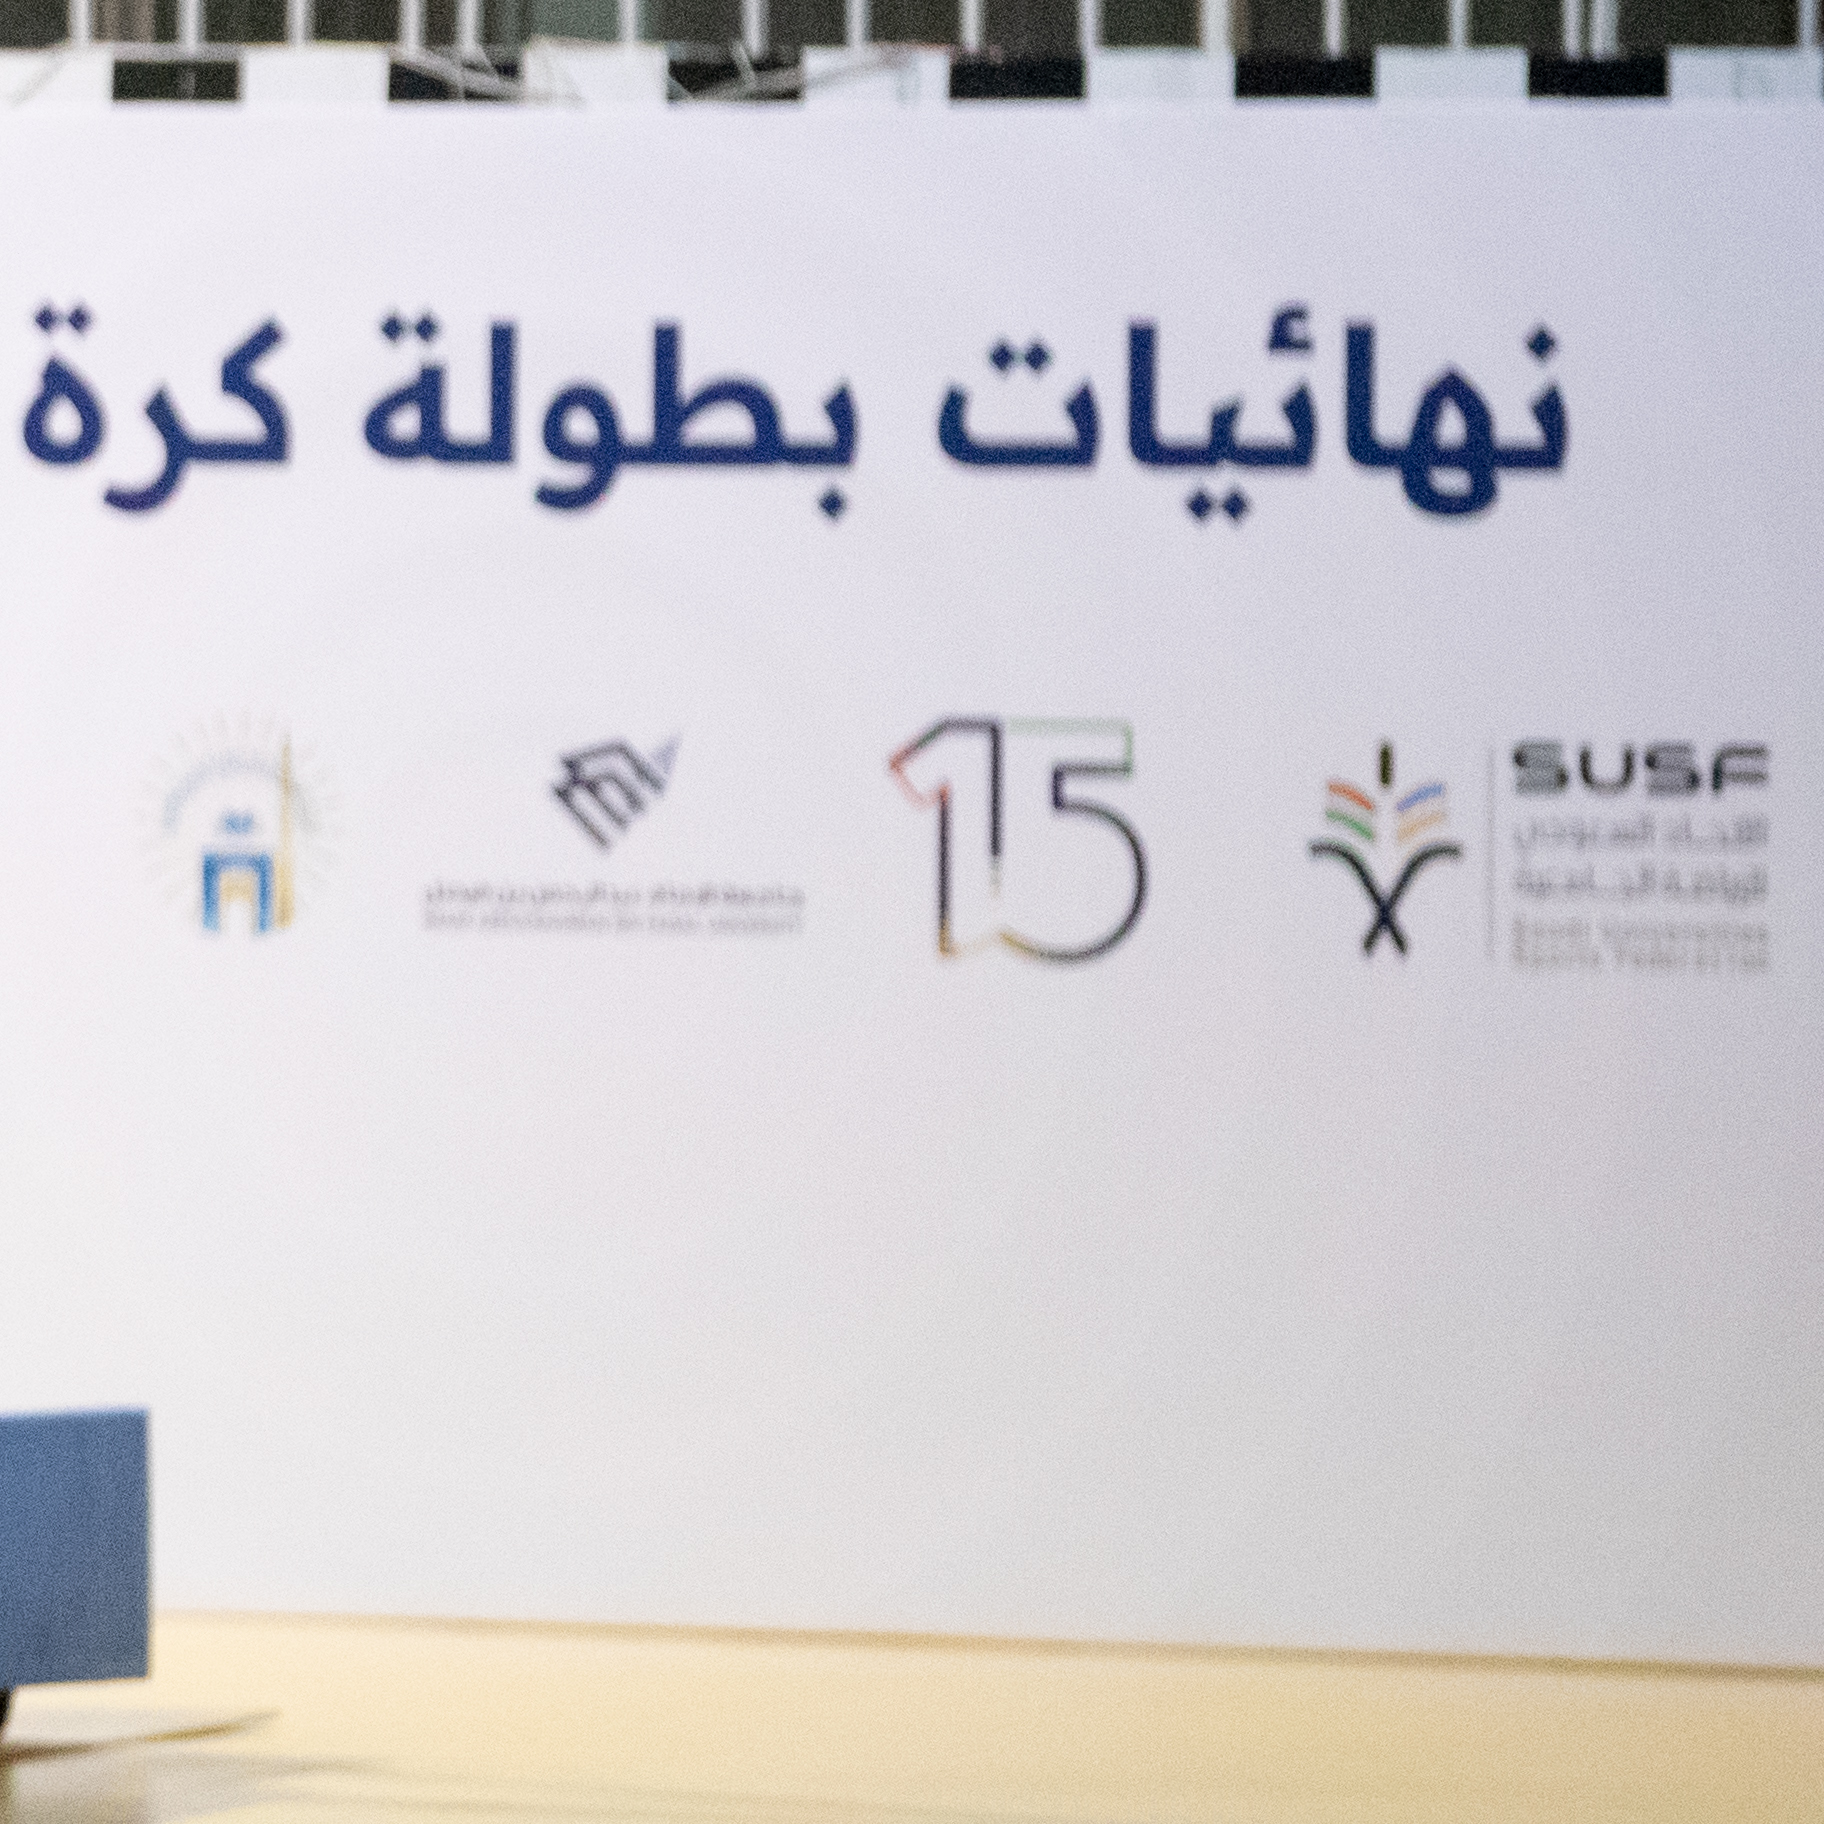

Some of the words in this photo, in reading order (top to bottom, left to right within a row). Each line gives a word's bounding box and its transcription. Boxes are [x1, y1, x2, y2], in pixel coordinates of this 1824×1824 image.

[23, 303, 290, 514] كرة
[363, 313, 859, 521] بطولة
[938, 302, 1569, 523] نهائيات
[1512, 740, 1769, 798] SUSF
